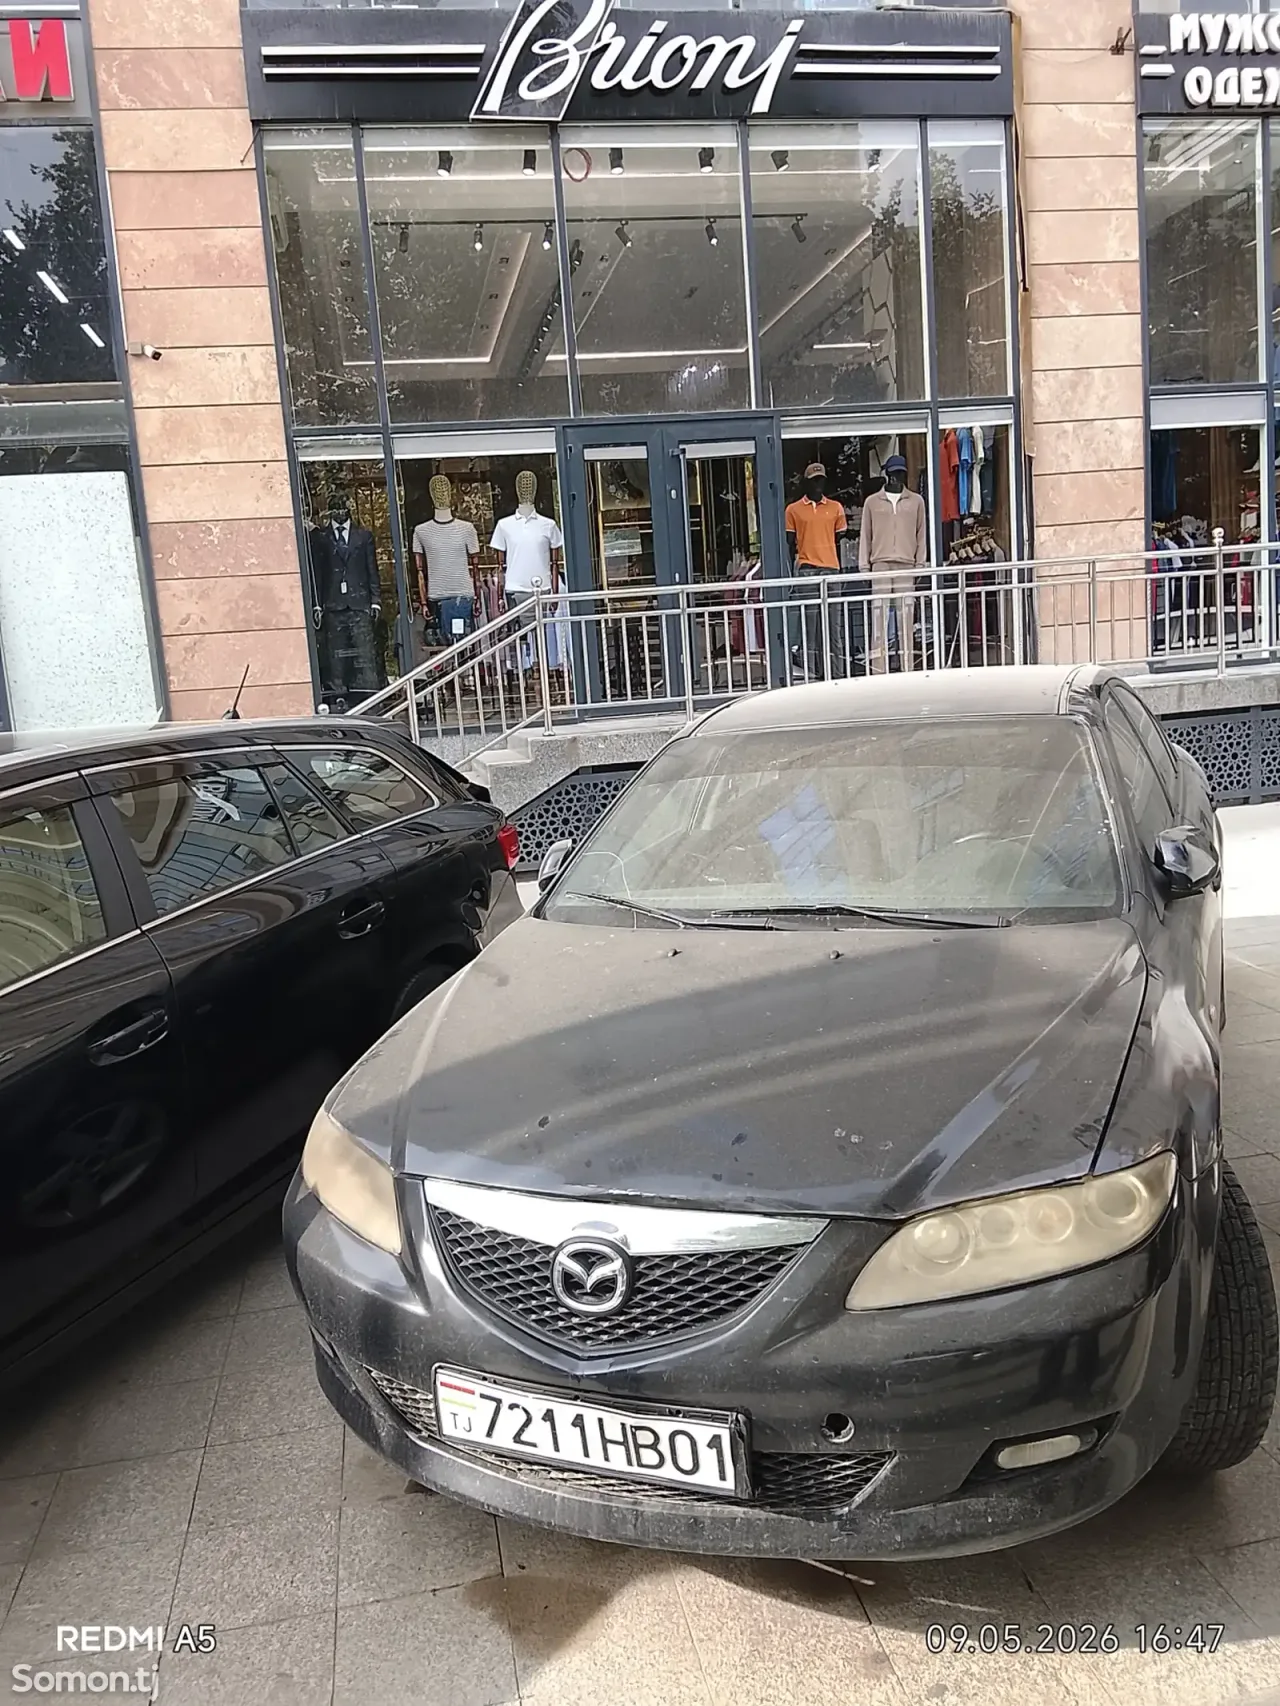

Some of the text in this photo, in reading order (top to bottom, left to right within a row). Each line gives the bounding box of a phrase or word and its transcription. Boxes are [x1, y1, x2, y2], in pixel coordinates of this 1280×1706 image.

[0, 18, 75, 101] И
[450, 1412, 472, 1433] TJ
[479, 1393, 727, 1482] 7211HB01
